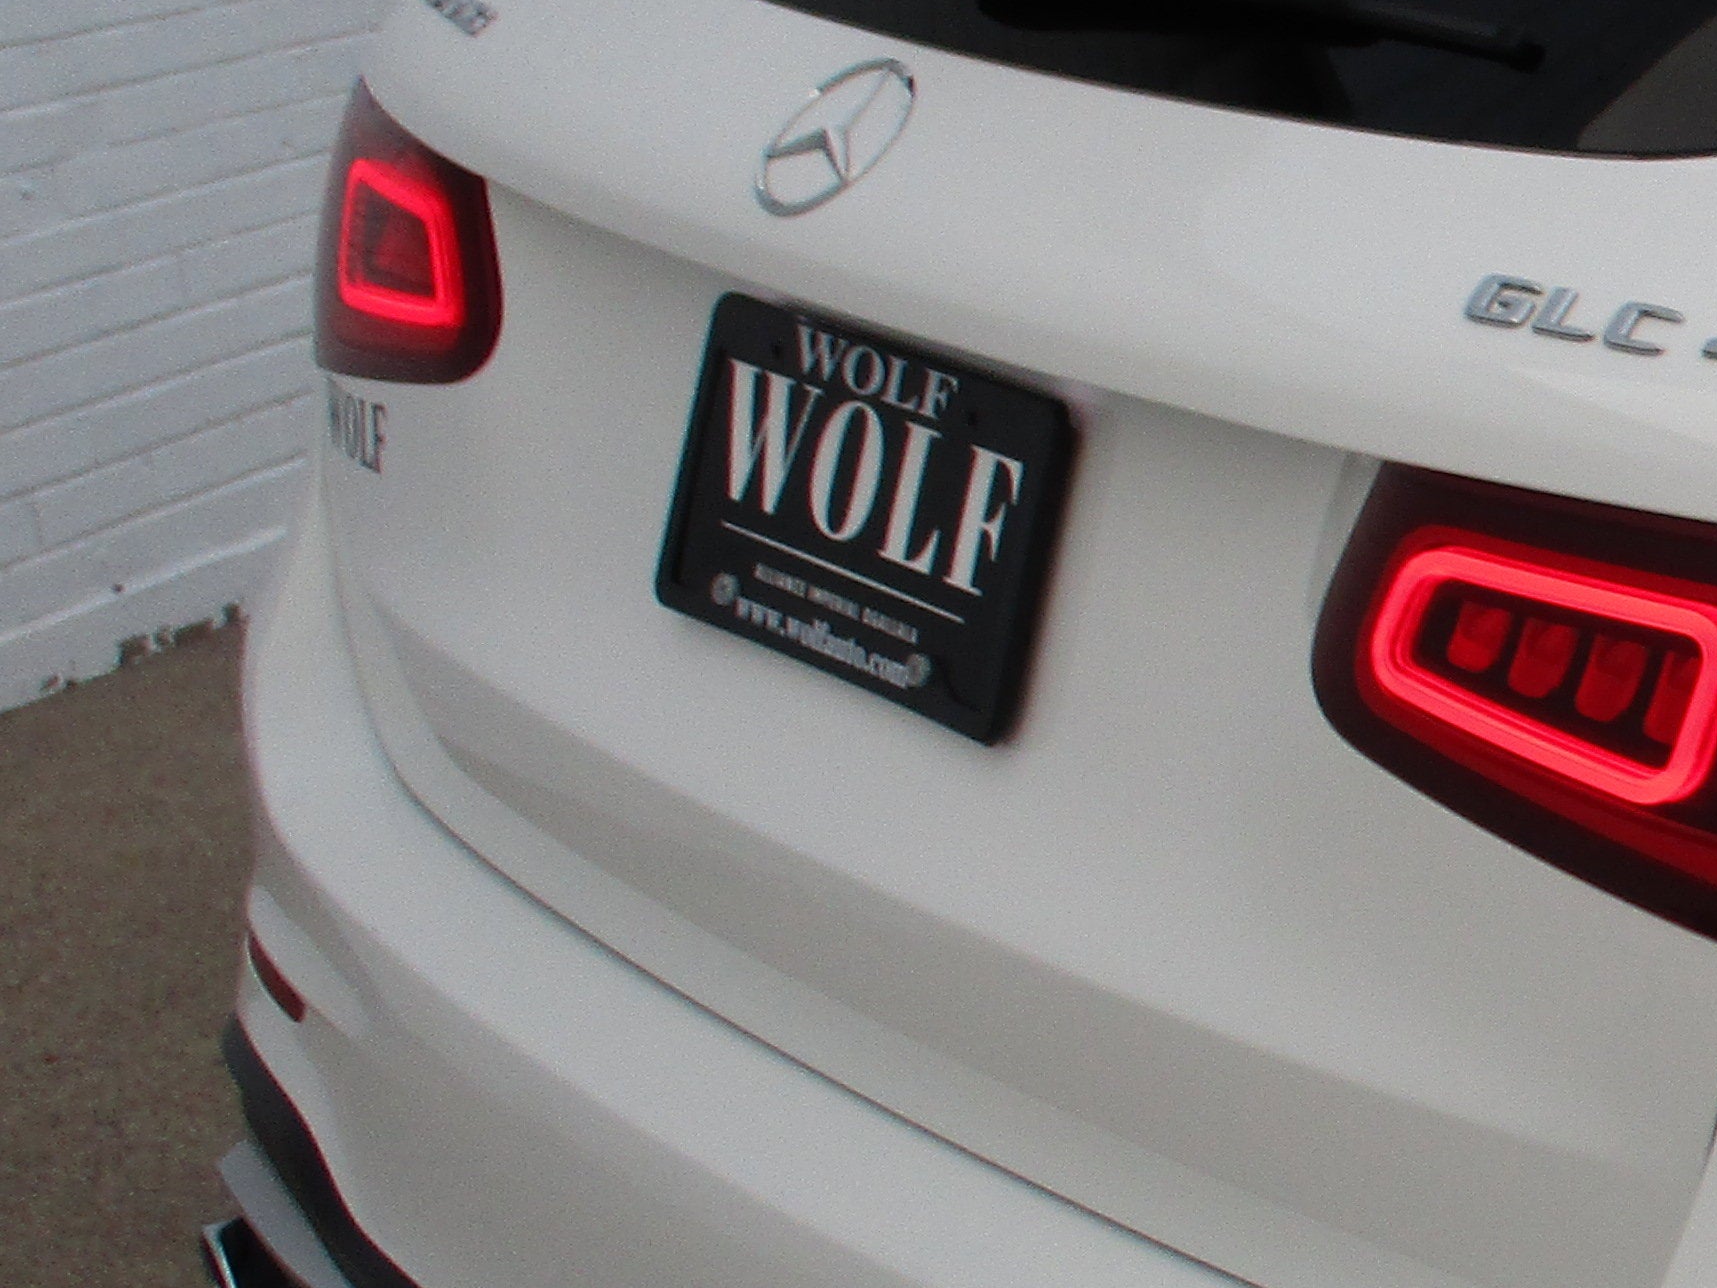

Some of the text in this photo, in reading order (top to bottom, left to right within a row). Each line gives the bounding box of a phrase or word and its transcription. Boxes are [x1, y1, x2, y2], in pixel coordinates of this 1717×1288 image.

[1463, 273, 1685, 356] GLC
[796, 324, 959, 420] WOLF
[725, 358, 1024, 595] WOLF
